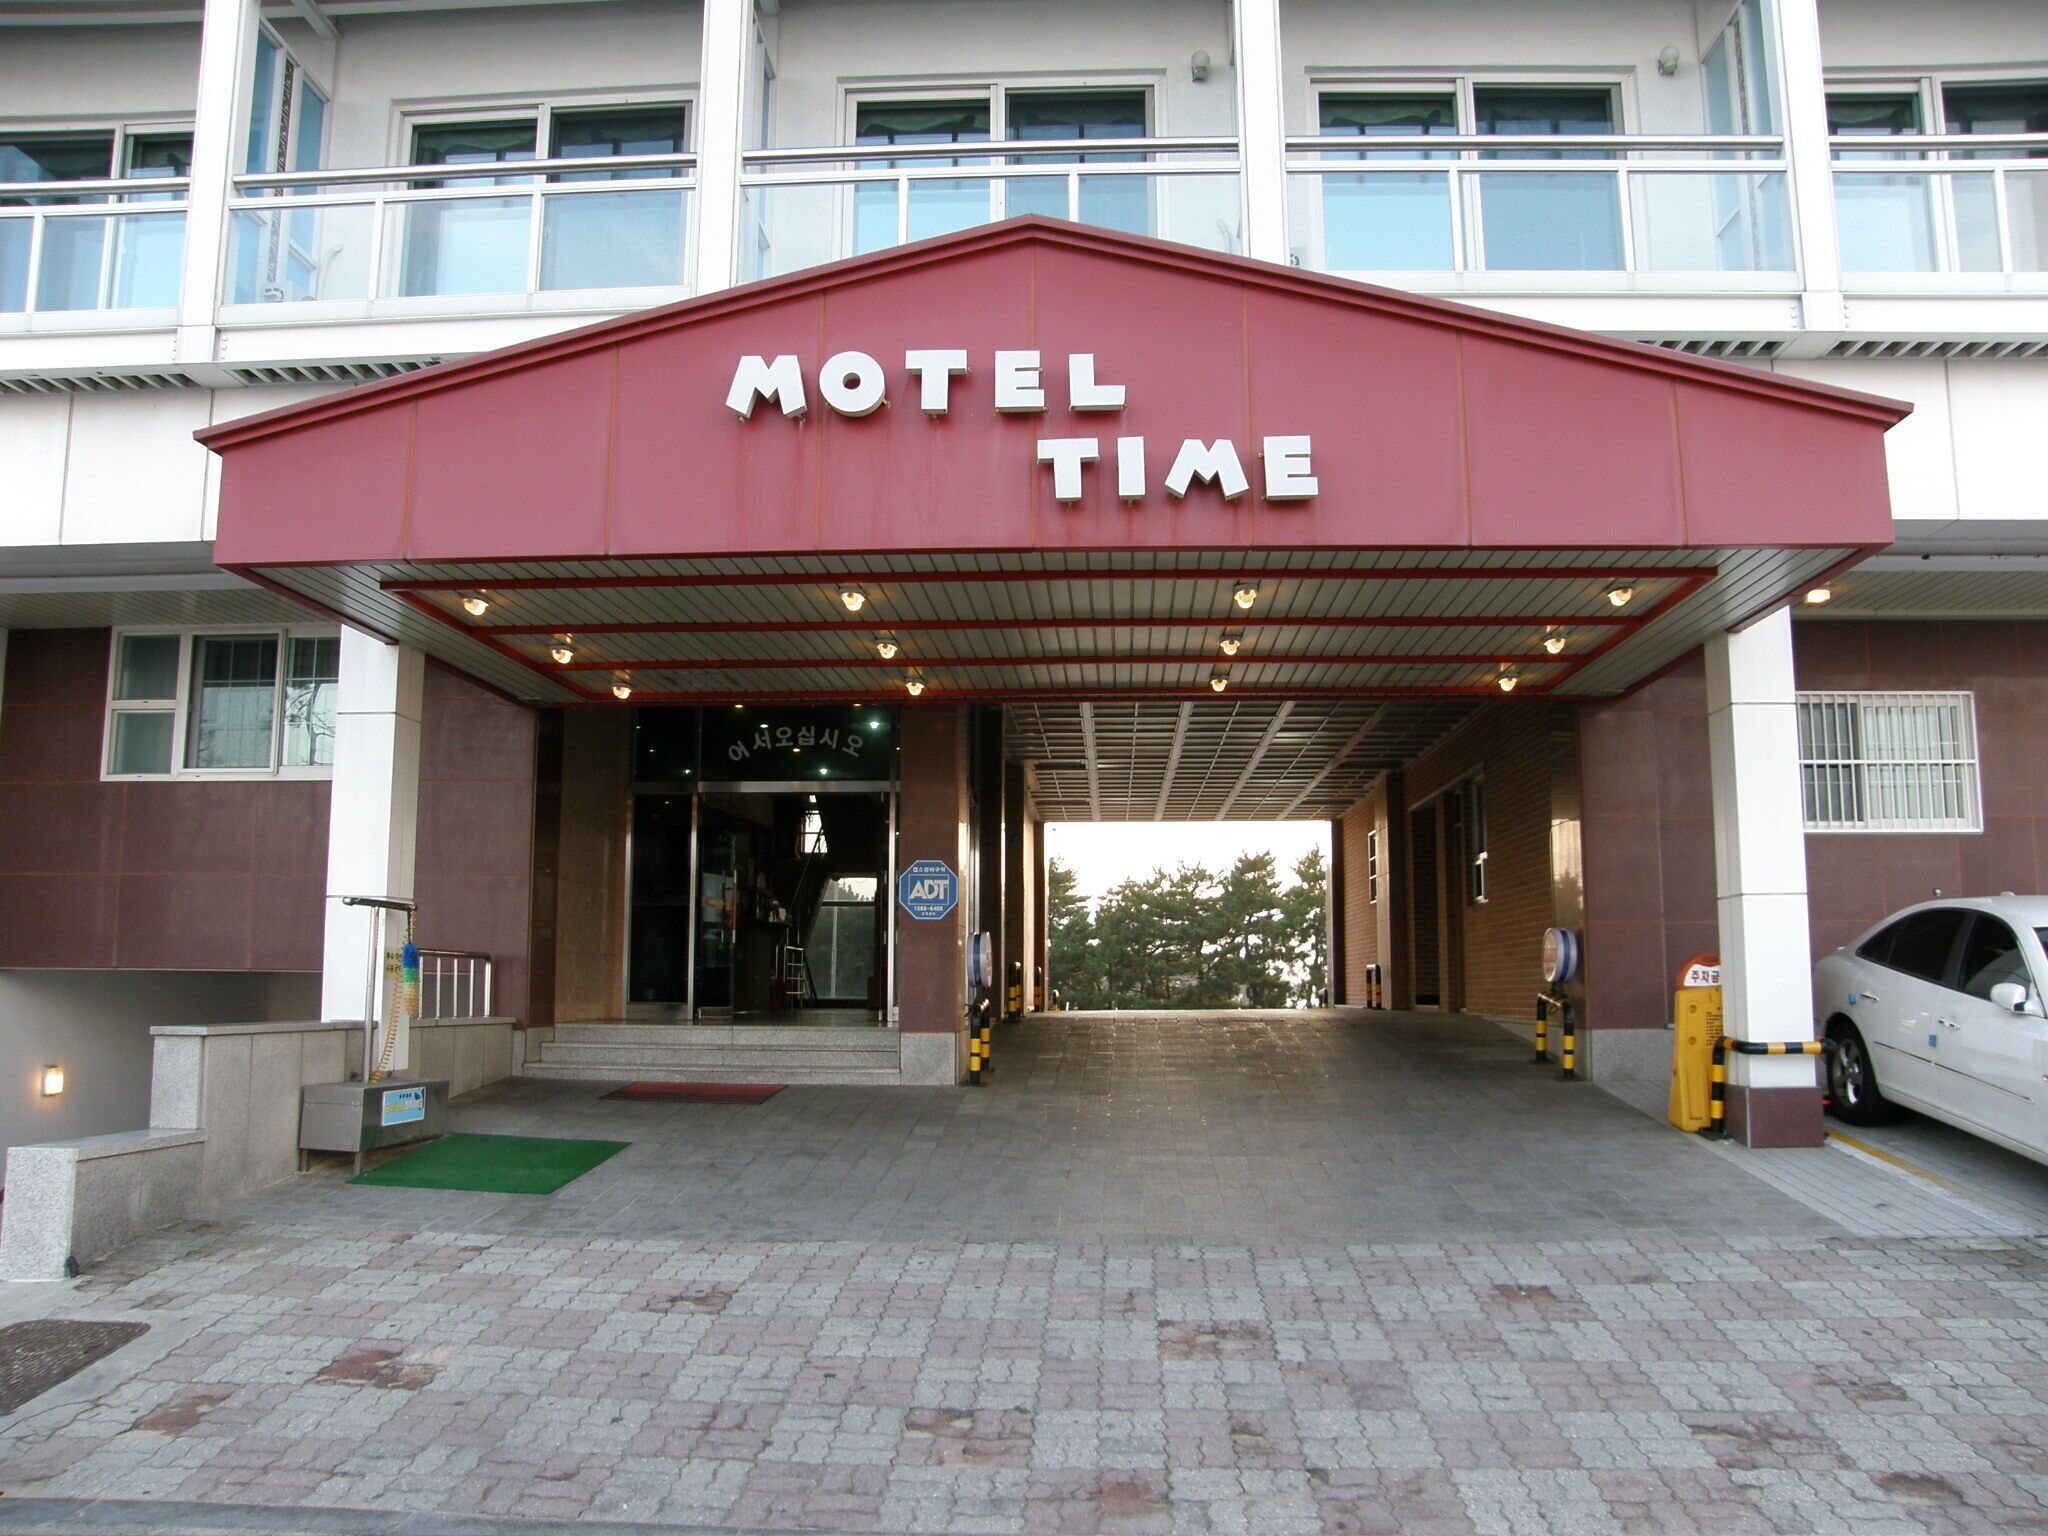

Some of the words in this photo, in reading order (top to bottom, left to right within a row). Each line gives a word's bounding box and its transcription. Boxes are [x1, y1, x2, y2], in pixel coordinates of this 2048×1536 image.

[725, 350, 1126, 418] MOTEL
[1036, 435, 1319, 502] TIME
[728, 726, 864, 761] 어서오십시오
[909, 879, 950, 900] ADT
[1691, 970, 1720, 984] 주차금
